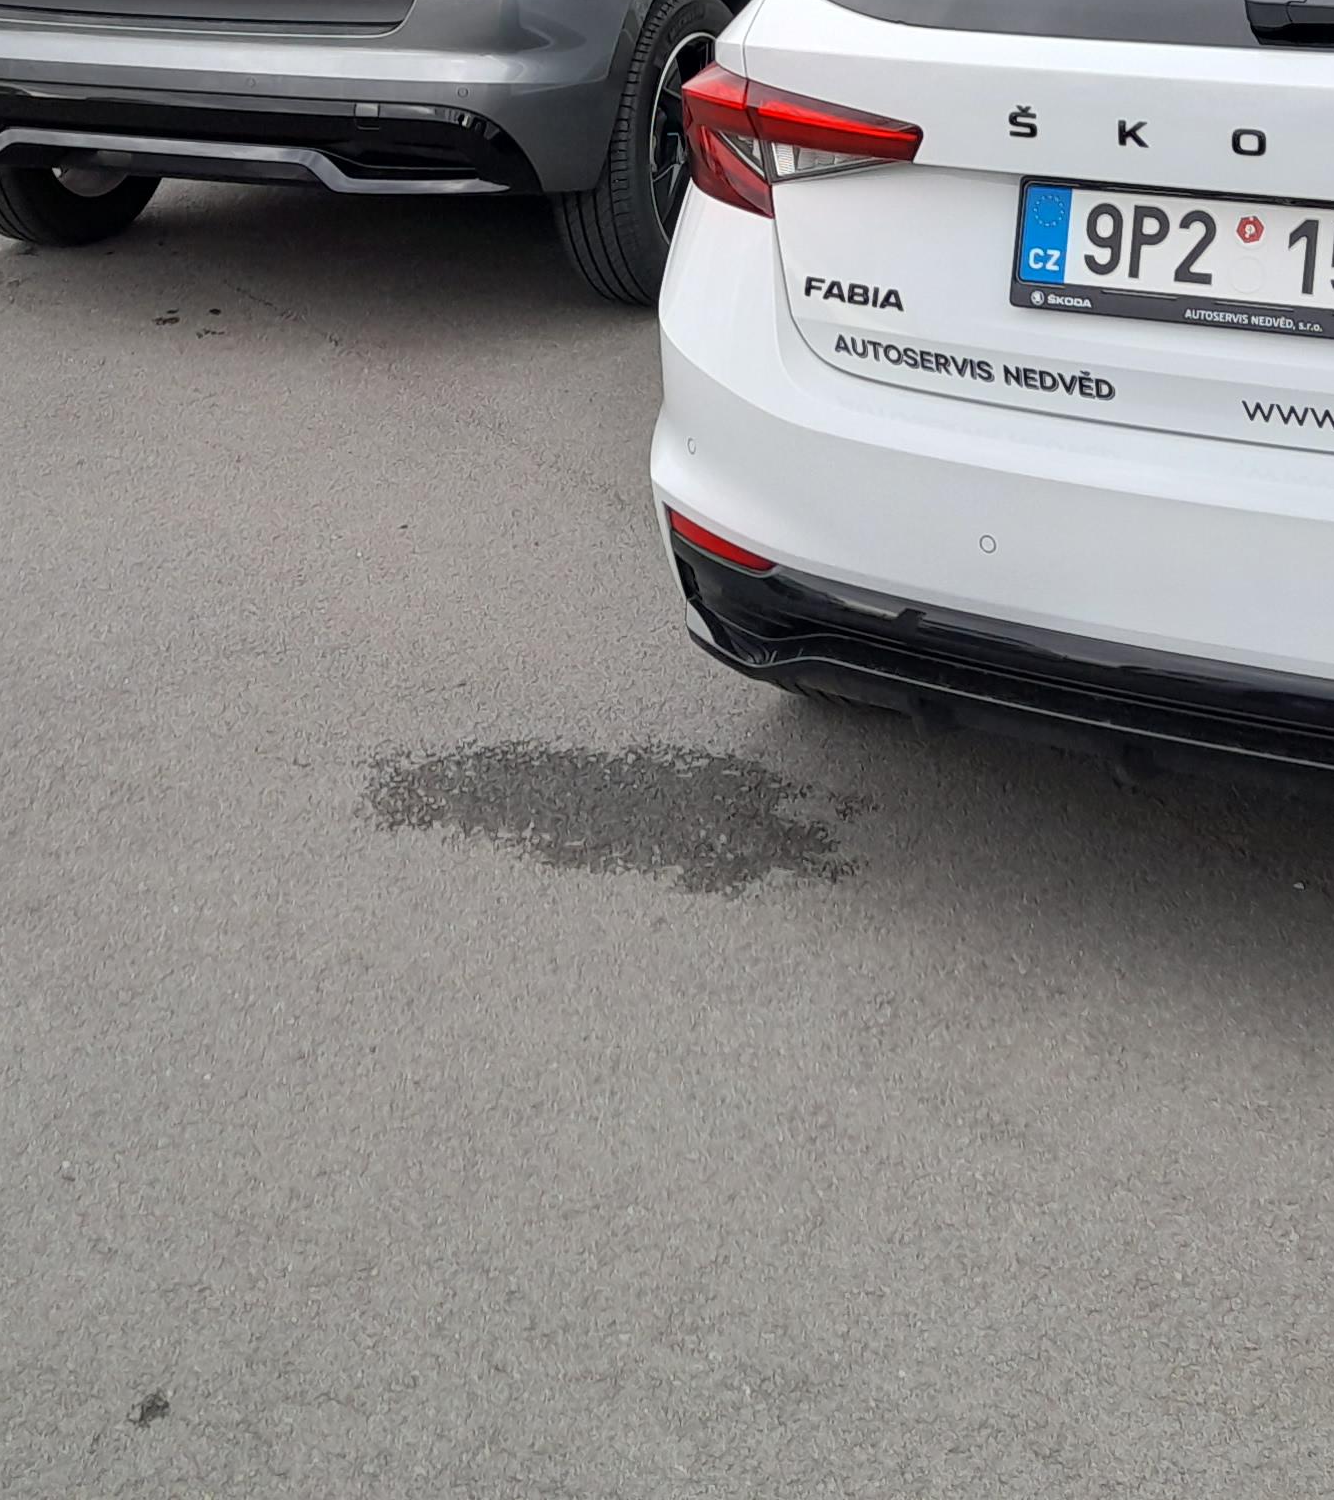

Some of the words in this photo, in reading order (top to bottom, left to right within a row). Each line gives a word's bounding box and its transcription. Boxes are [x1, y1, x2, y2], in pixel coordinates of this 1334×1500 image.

[1028, 247, 1061, 272] CZ
[1083, 203, 1217, 286] 9P2
[804, 275, 904, 312] FABIA
[1047, 293, 1092, 308] ŠKODA
[1184, 308, 1249, 326] AUTOSERVIS
[1251, 312, 1296, 330] NEDVĚD,
[1298, 321, 1323, 332] s.r.o.
[835, 334, 995, 383] AUTOSERVIS
[1003, 364, 1116, 400] NEDVĚD
